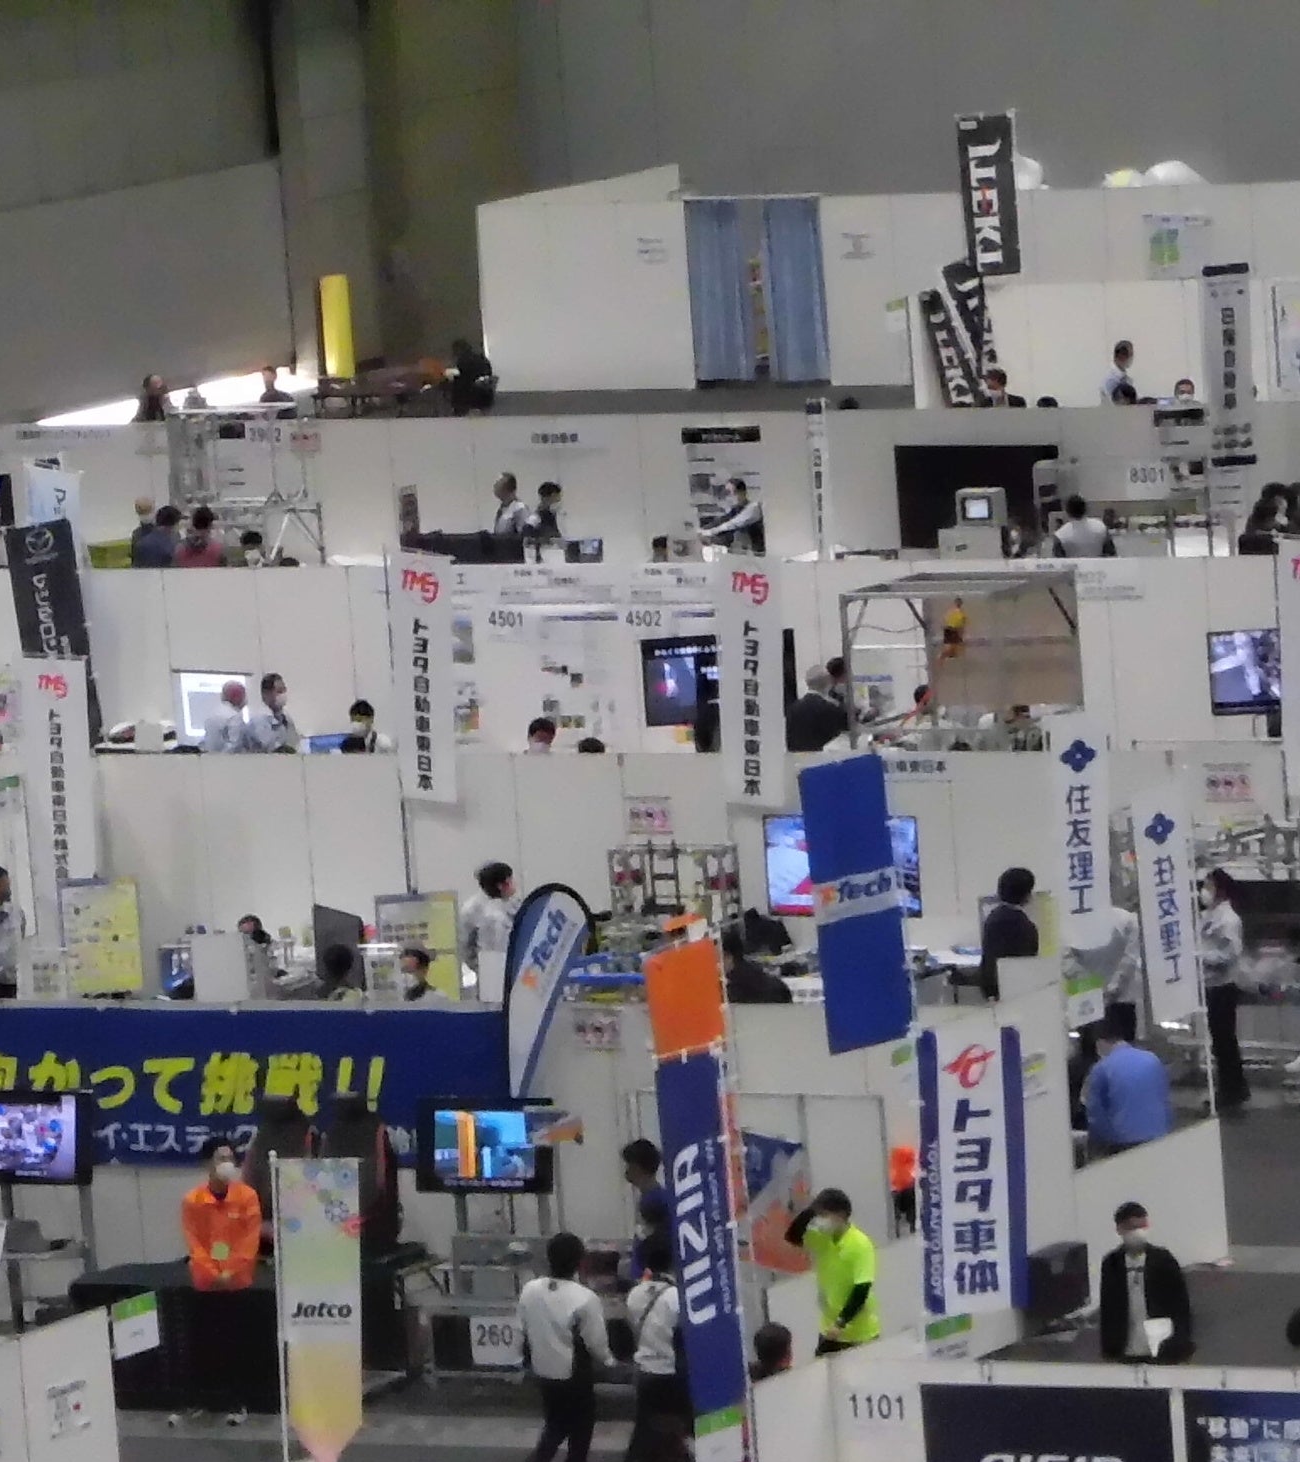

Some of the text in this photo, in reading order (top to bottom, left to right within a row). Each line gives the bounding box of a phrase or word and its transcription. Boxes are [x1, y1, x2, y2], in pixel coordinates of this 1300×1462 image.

[488, 611, 524, 628] 4501
[626, 610, 663, 627] 4502
[1066, 784, 1095, 916] 住友理工
[952, 1099, 1000, 1296] トヨタ車体
[476, 1319, 518, 1346] 260
[848, 1392, 906, 1420] 1101
